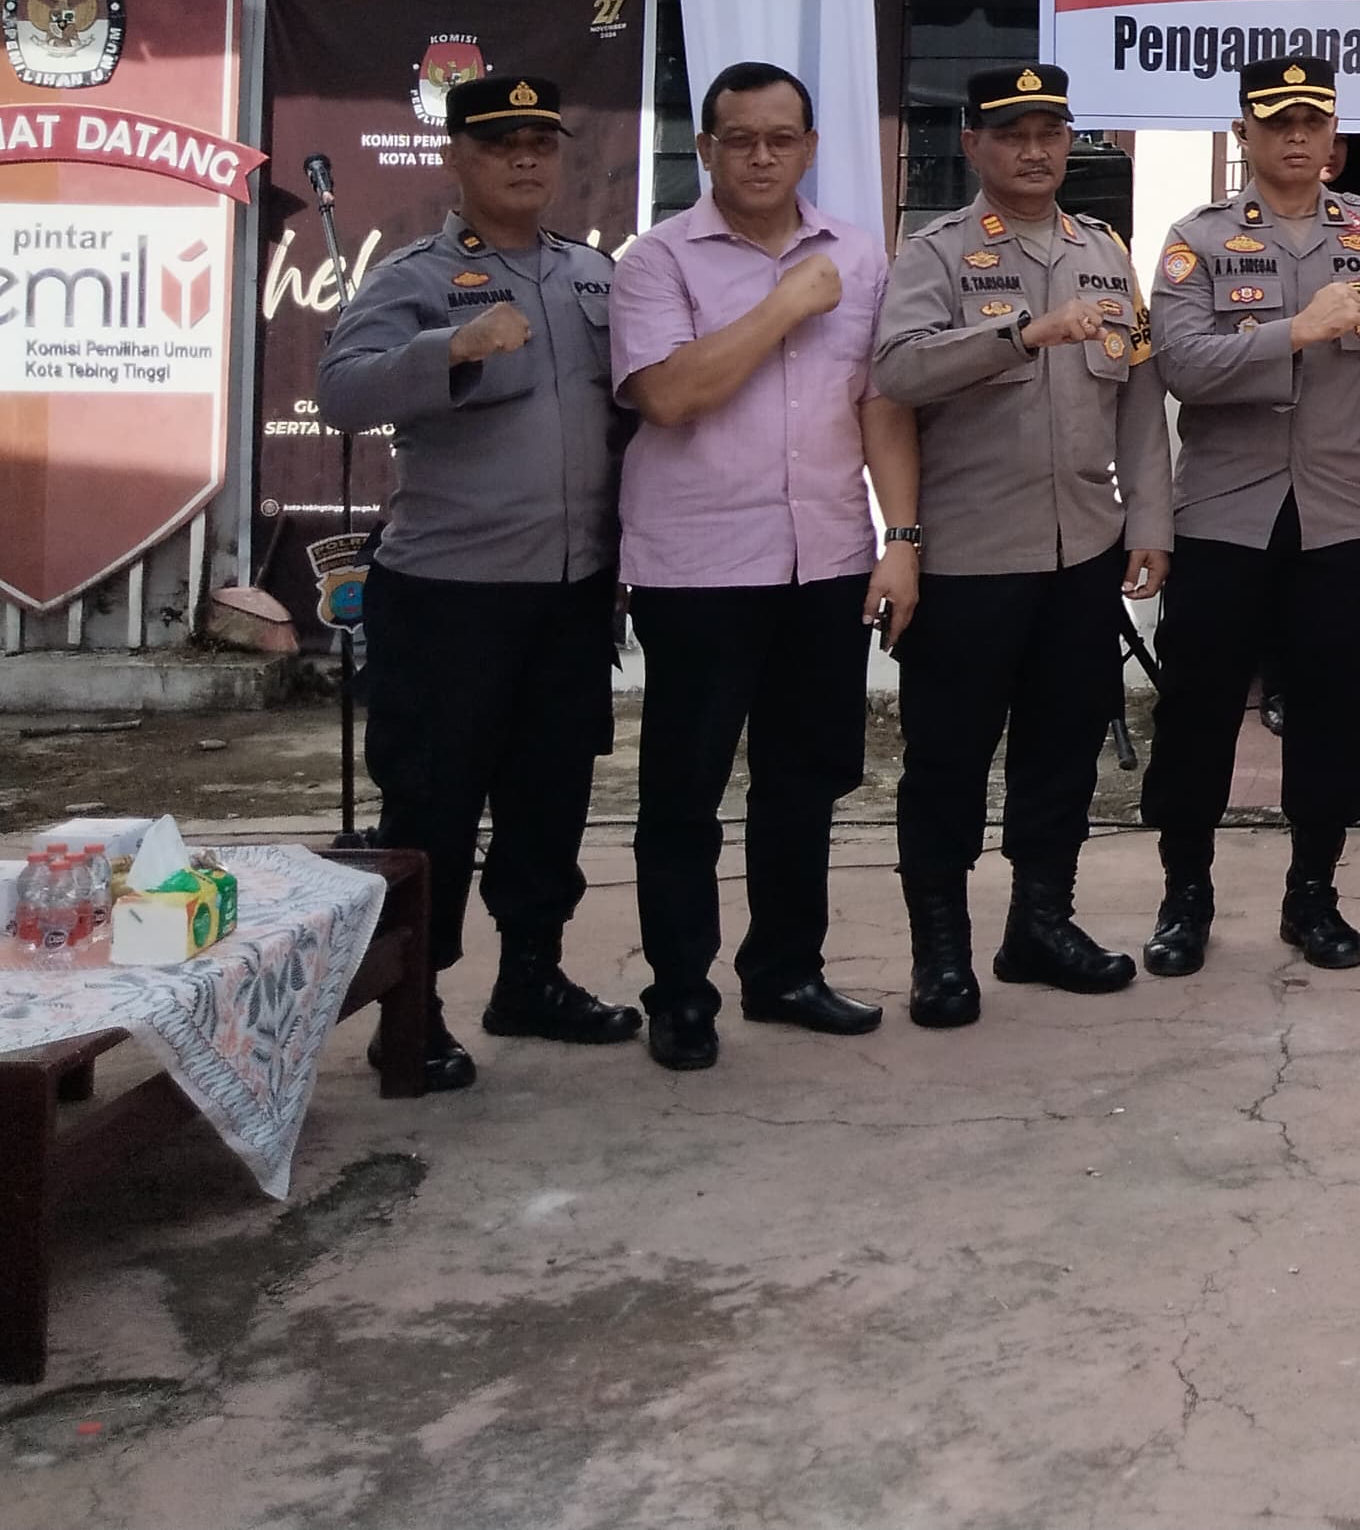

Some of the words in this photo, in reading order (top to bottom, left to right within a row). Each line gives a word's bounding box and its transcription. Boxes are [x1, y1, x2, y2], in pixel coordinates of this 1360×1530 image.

[430, 33, 478, 45] KOMISI
[76, 115, 240, 186] DATANG
[361, 134, 410, 148] KOMISI
[379, 152, 418, 166] KOTA
[13, 222, 114, 256] pintar
[1079, 273, 1129, 293] POLRI
[26, 339, 81, 357] Komisi
[86, 340, 160, 358] Pemilihan
[164, 342, 213, 359] Umum
[25, 361, 63, 379] Kota
[68, 362, 119, 384] Tebing
[124, 363, 171, 384] Tinggi
[264, 421, 320, 436] SERTA
